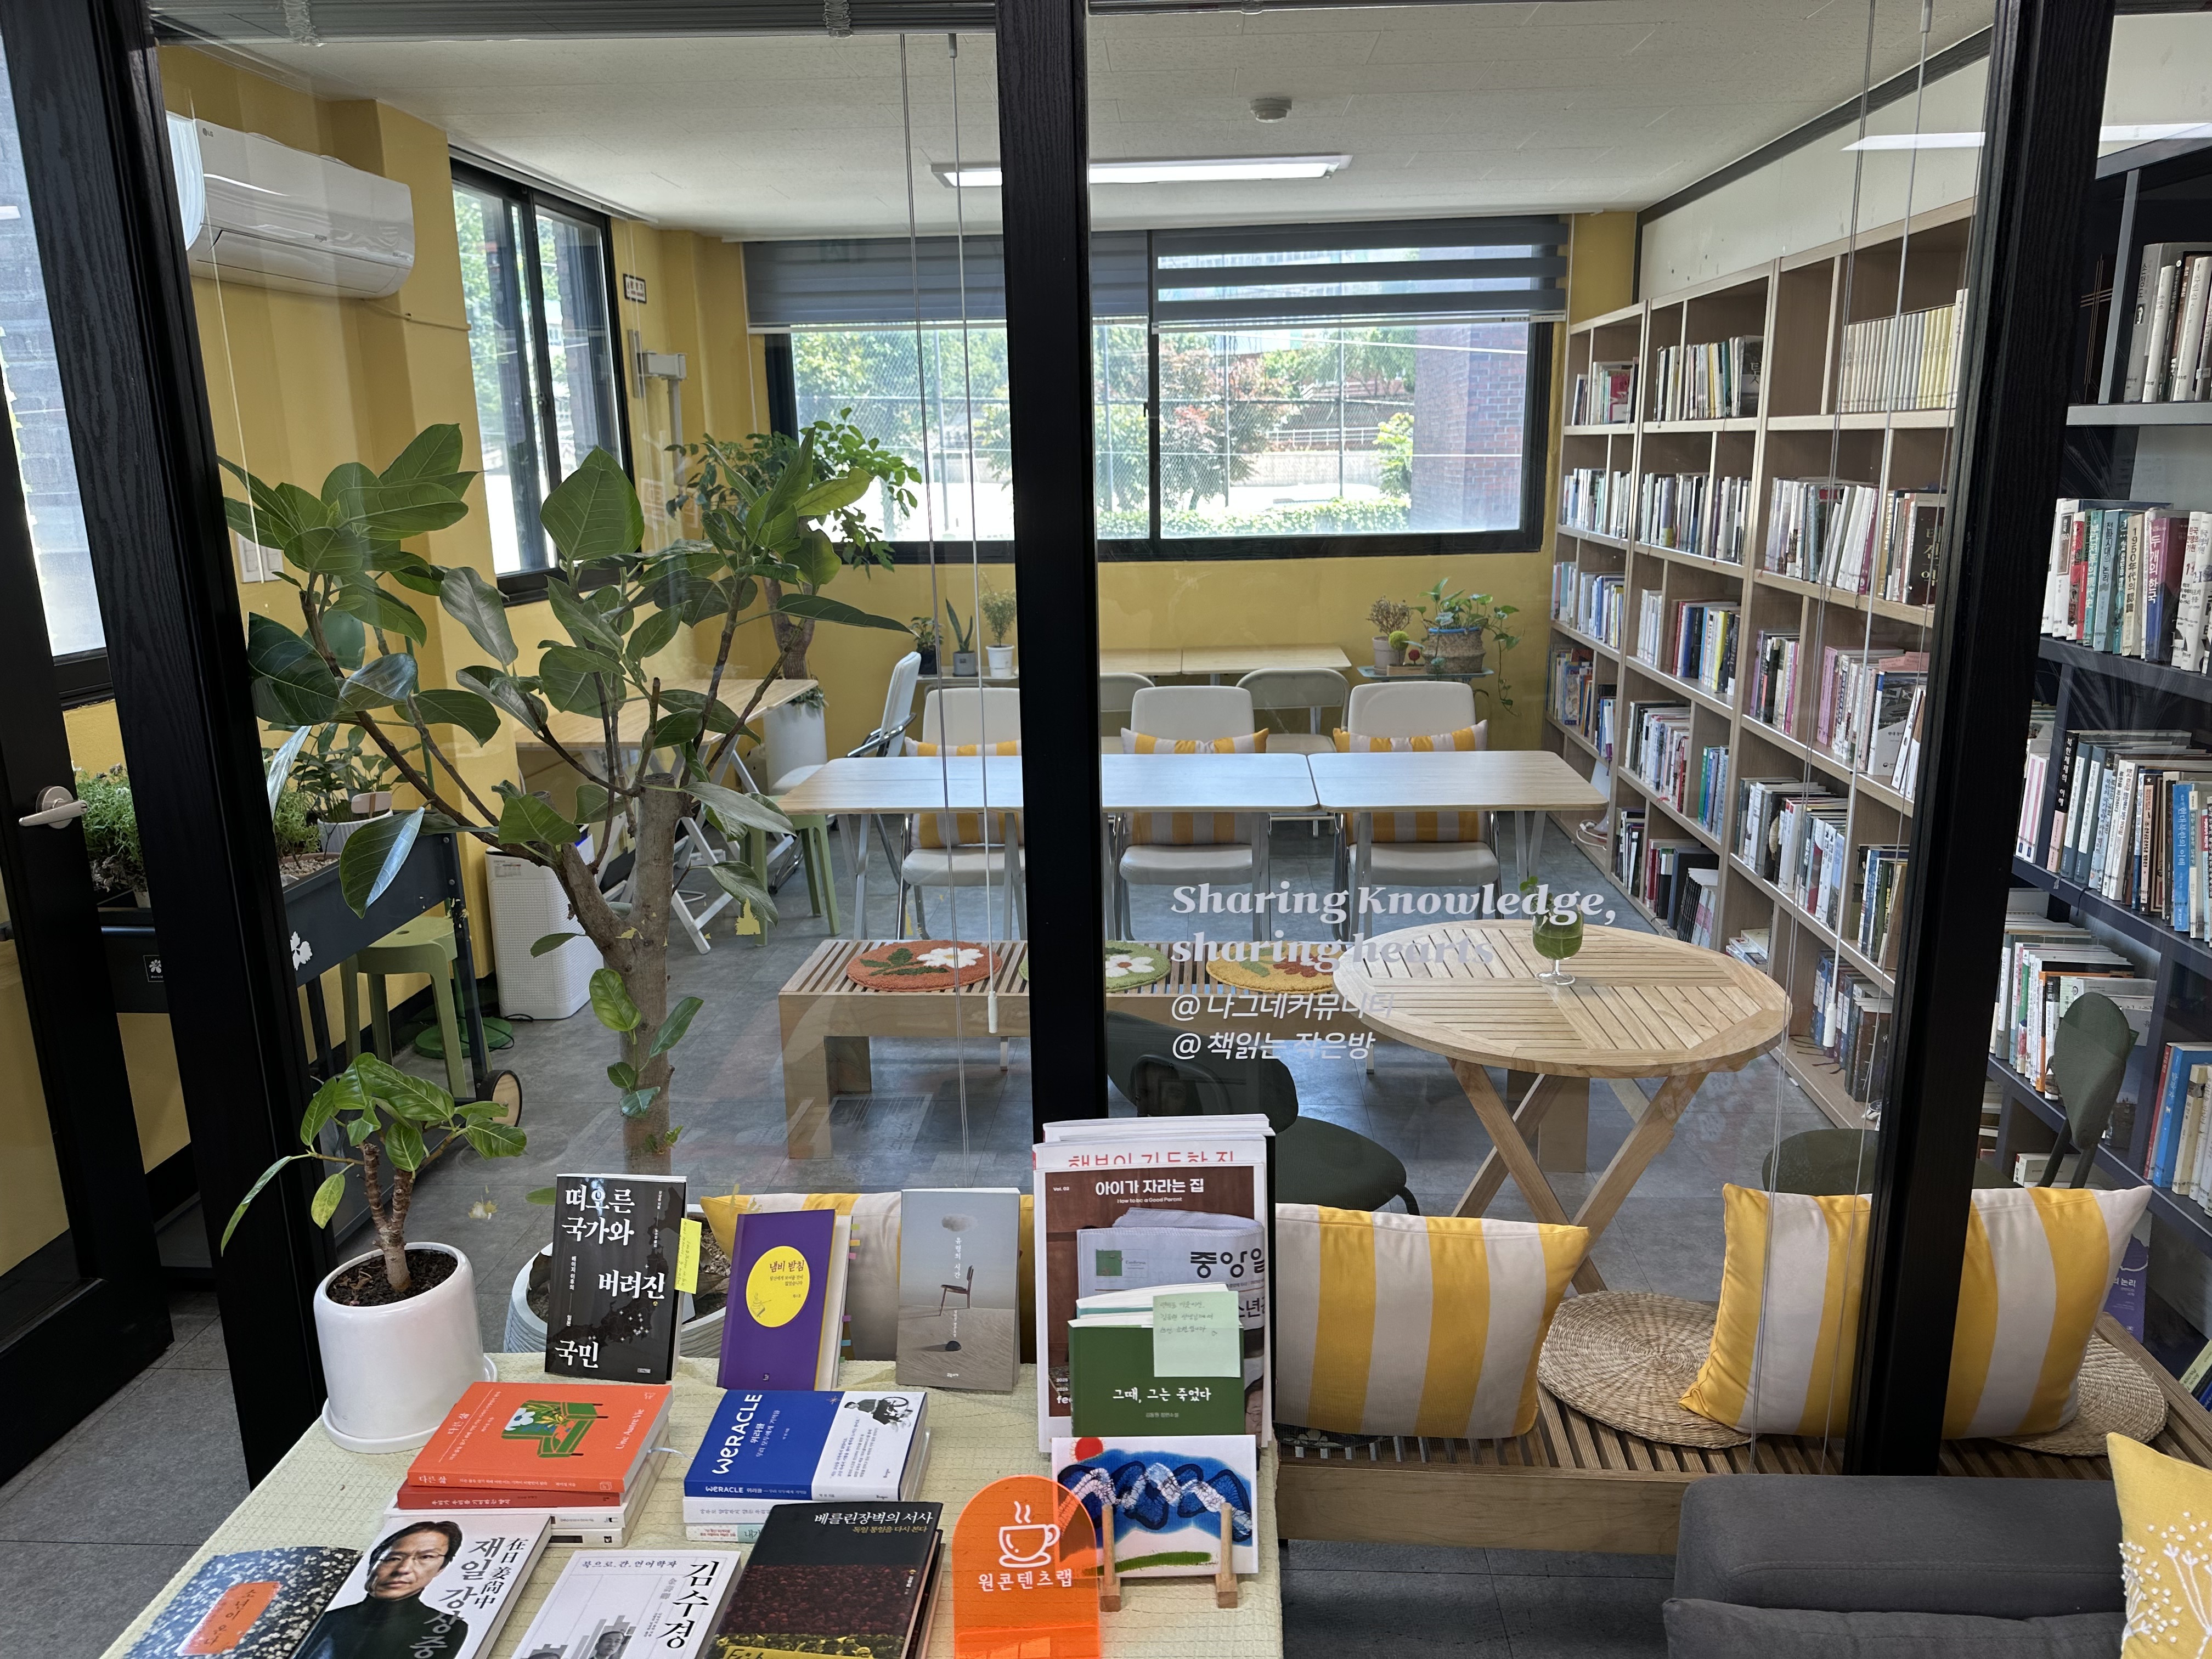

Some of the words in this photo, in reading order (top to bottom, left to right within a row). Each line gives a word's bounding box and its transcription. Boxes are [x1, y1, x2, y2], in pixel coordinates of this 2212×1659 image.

[2151, 535, 2161, 548] 두
[2149, 550, 2160, 575] 개의
[2148, 577, 2159, 603] 한국
[1171, 881, 1349, 924] Sharing
[1358, 883, 1617, 926] Knowledge,
[1171, 930, 1341, 974] sharing
[1352, 932, 1494, 964] hearts
[1171, 994, 1200, 1022] @
[1207, 992, 1395, 1022] 나그네커뮤니티
[1172, 1032, 1201, 1060] @
[1207, 1032, 1285, 1061] 책읽는
[1294, 1031, 1376, 1060] 작은방
[566, 1184, 635, 1214] 떠오른
[1096, 1180, 1139, 1195] 아이가
[1142, 1179, 1186, 1194] 자라는
[1190, 1178, 1204, 1193] 집
[562, 1216, 635, 1246] 국가와
[770, 1260, 785, 1272] 냄비
[788, 1260, 805, 1272] 받침
[955, 1263, 961, 1279] 시간
[599, 1269, 665, 1300] 버려진
[2121, 1278, 2136, 1288] 논리
[555, 1340, 599, 1369] 국민
[1113, 1387, 1142, 1403] 그때,
[1147, 1388, 1171, 1402] 그는
[1176, 1387, 1211, 1402] 죽었다
[615, 1435, 629, 1451] Une
[624, 1417, 639, 1436] Autre
[635, 1408, 645, 1421] Vie
[814, 1511, 901, 1526] 베를린장벽의
[901, 1511, 934, 1525] 서사
[461, 1537, 503, 1581] 재일
[634, 1560, 678, 1568] 언어학자
[978, 1568, 1073, 1592] 원콘텐츠랩
[656, 1560, 720, 1649] 김수경
[410, 1586, 478, 1659] 강상중
